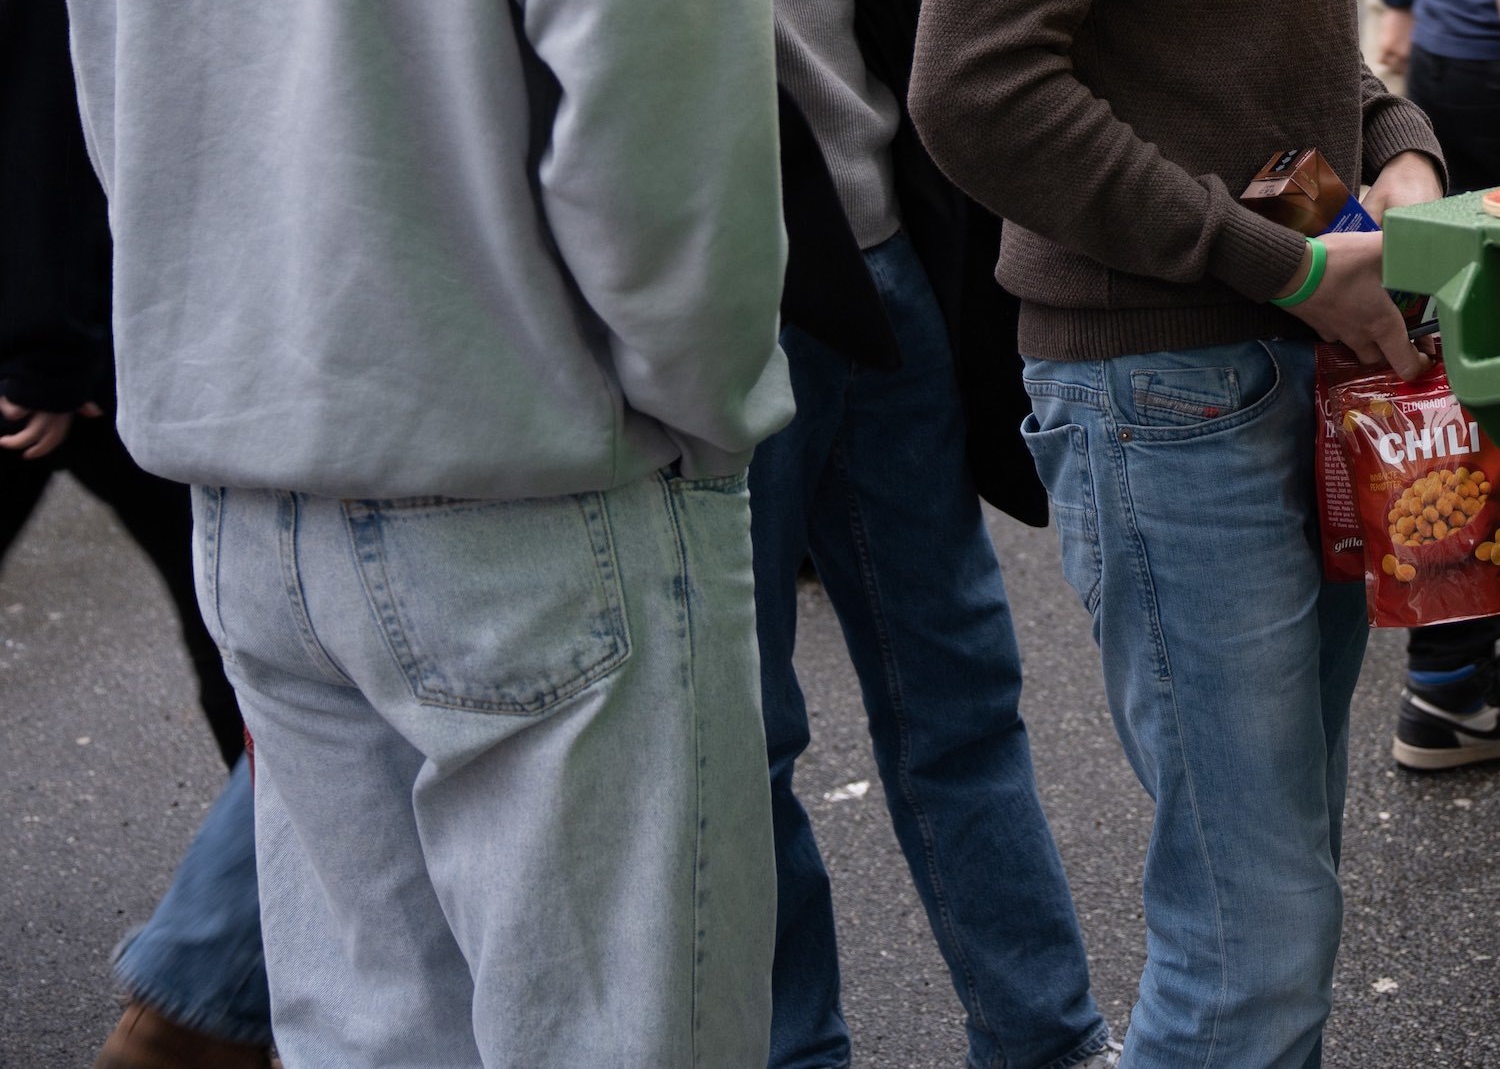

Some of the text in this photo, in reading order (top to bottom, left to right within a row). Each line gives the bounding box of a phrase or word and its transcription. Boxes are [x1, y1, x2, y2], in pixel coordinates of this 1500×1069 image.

[1402, 397, 1447, 414] ELDORADO
[1380, 421, 1480, 465] CHILI
[1334, 537, 1365, 553] giffla
